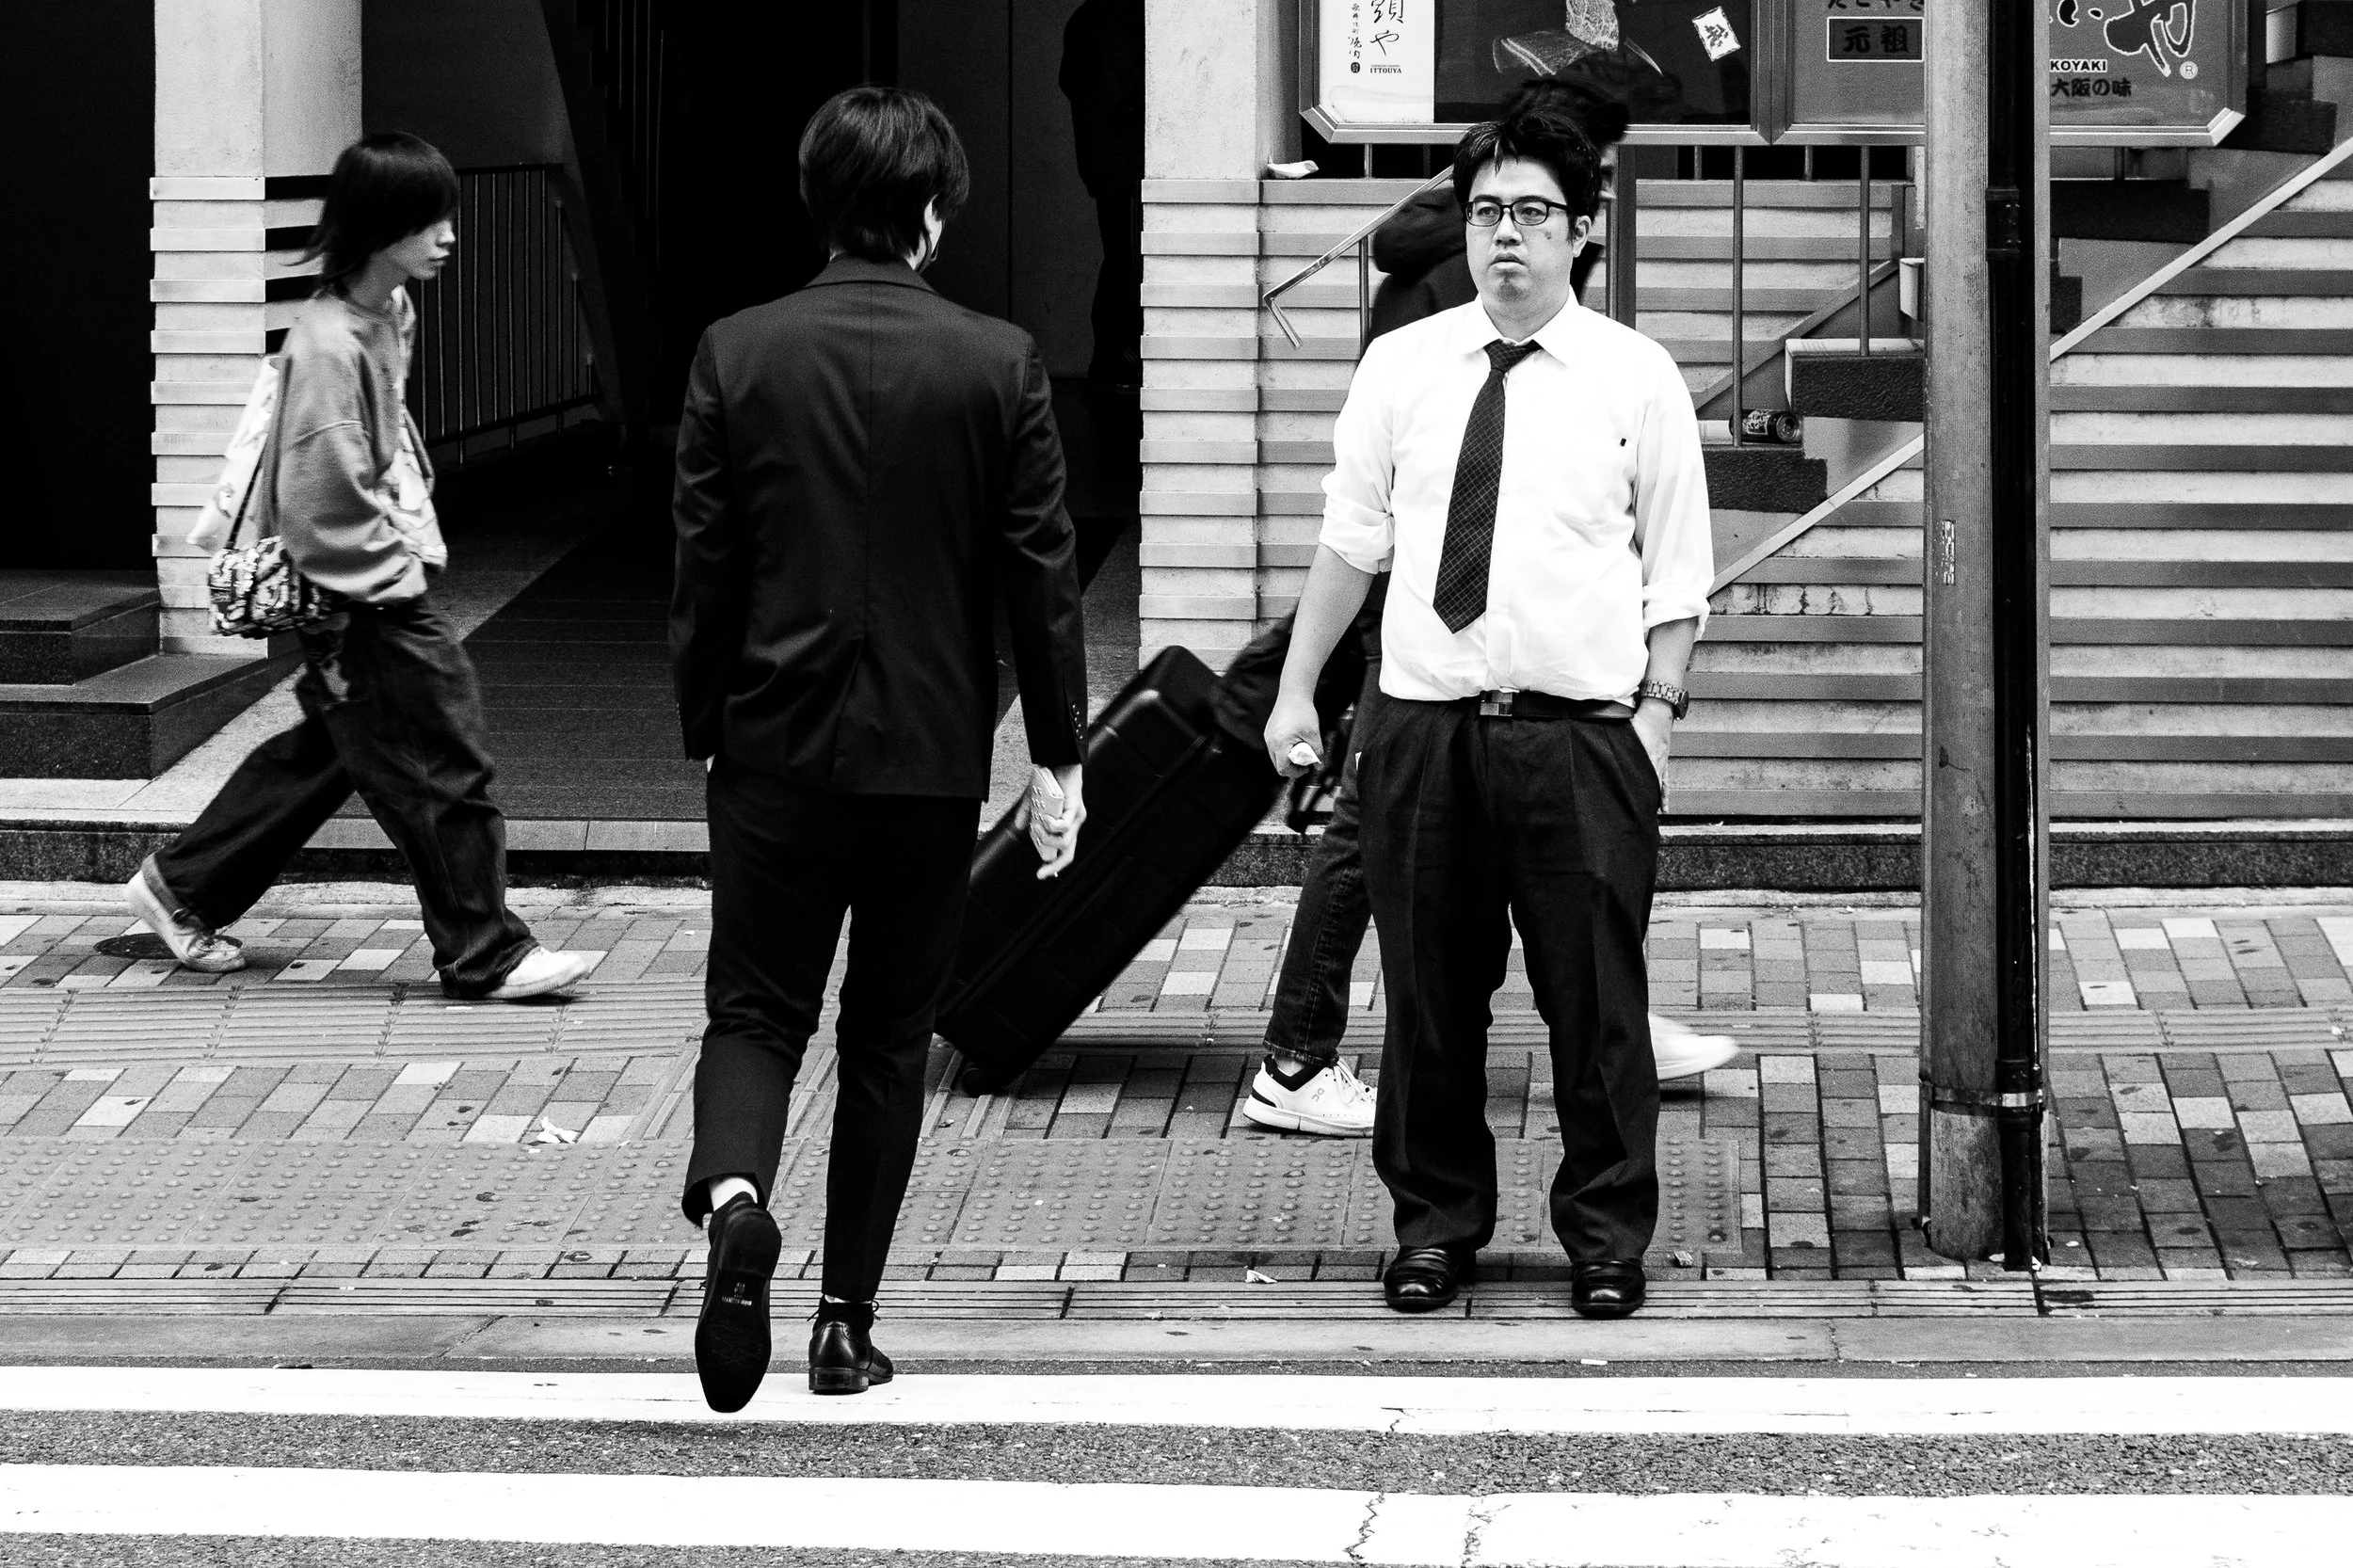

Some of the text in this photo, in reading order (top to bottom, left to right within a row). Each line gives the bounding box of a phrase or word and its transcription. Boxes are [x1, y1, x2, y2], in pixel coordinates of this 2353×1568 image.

[1843, 24, 1909, 53] 元祖
[2051, 78, 2132, 97] 大阪の味
